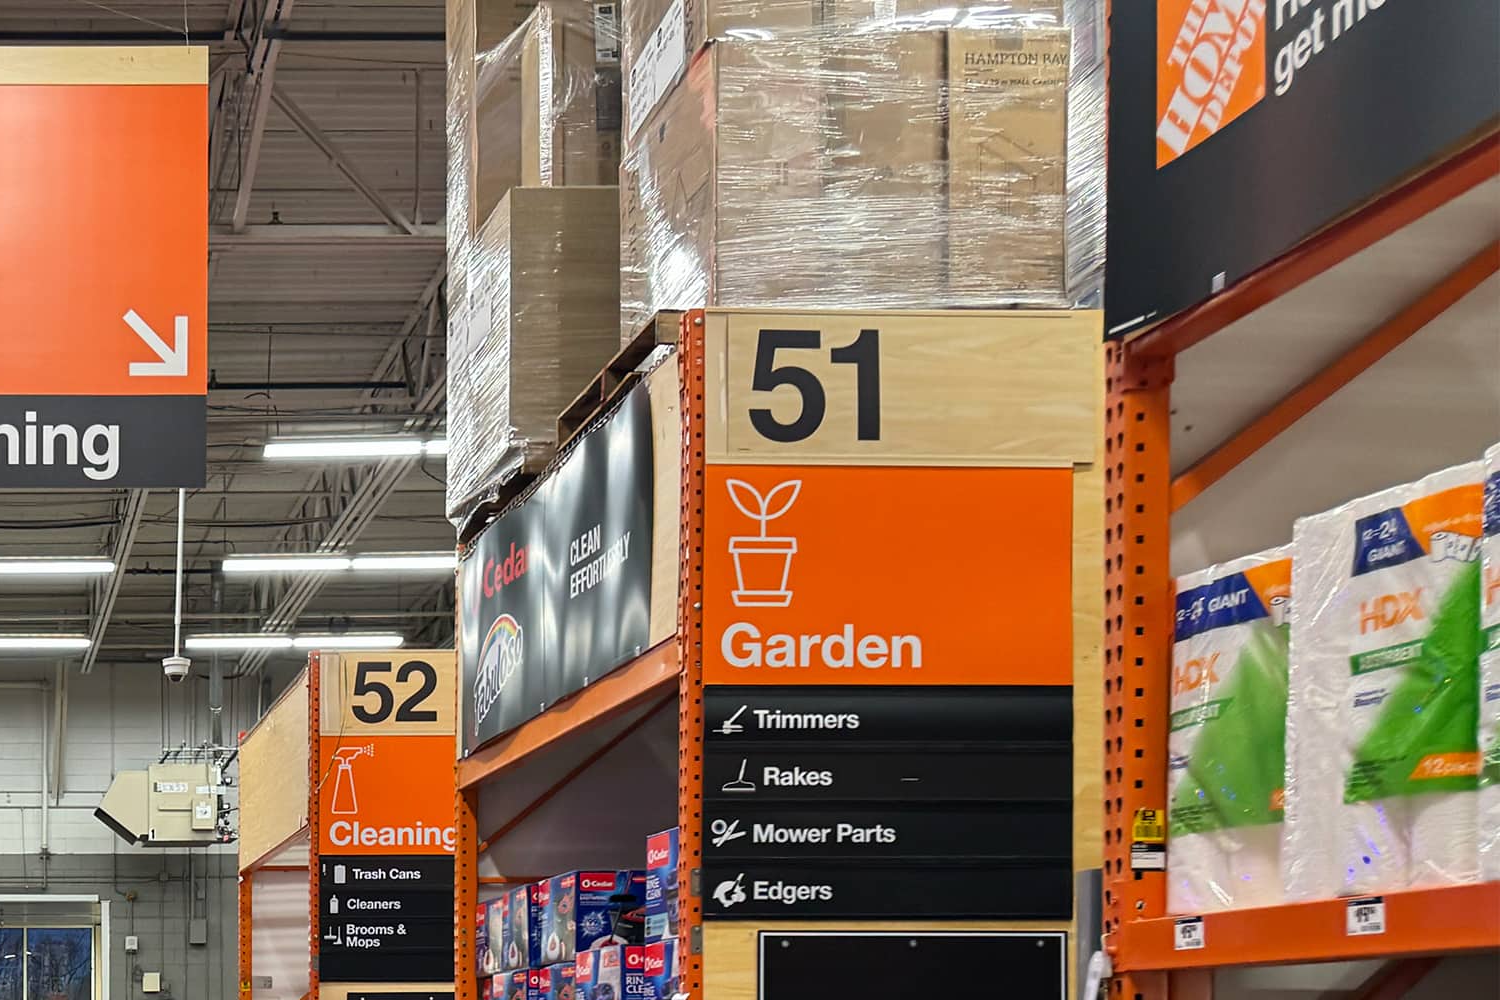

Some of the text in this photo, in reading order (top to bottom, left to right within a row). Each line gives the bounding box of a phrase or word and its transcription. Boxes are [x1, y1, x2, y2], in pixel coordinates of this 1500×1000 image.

[965, 52, 1068, 66] HAMPTON BAY
[1274, 8, 1325, 97] get
[748, 329, 881, 443] 51
[570, 524, 601, 567] CLEAN
[1359, 587, 1426, 636] HDX
[721, 622, 923, 669] Garden
[352, 661, 438, 724] 52
[753, 710, 860, 730] Trimmers
[763, 767, 833, 787] Rakes
[329, 821, 456, 852] Cleaning
[753, 824, 896, 843] Mower Parts
[352, 868, 421, 881] Trash Cans
[753, 881, 833, 905] Edgers
[346, 899, 401, 910] Cleaners
[346, 924, 407, 936] Brooms &
[346, 936, 381, 949] Mops
